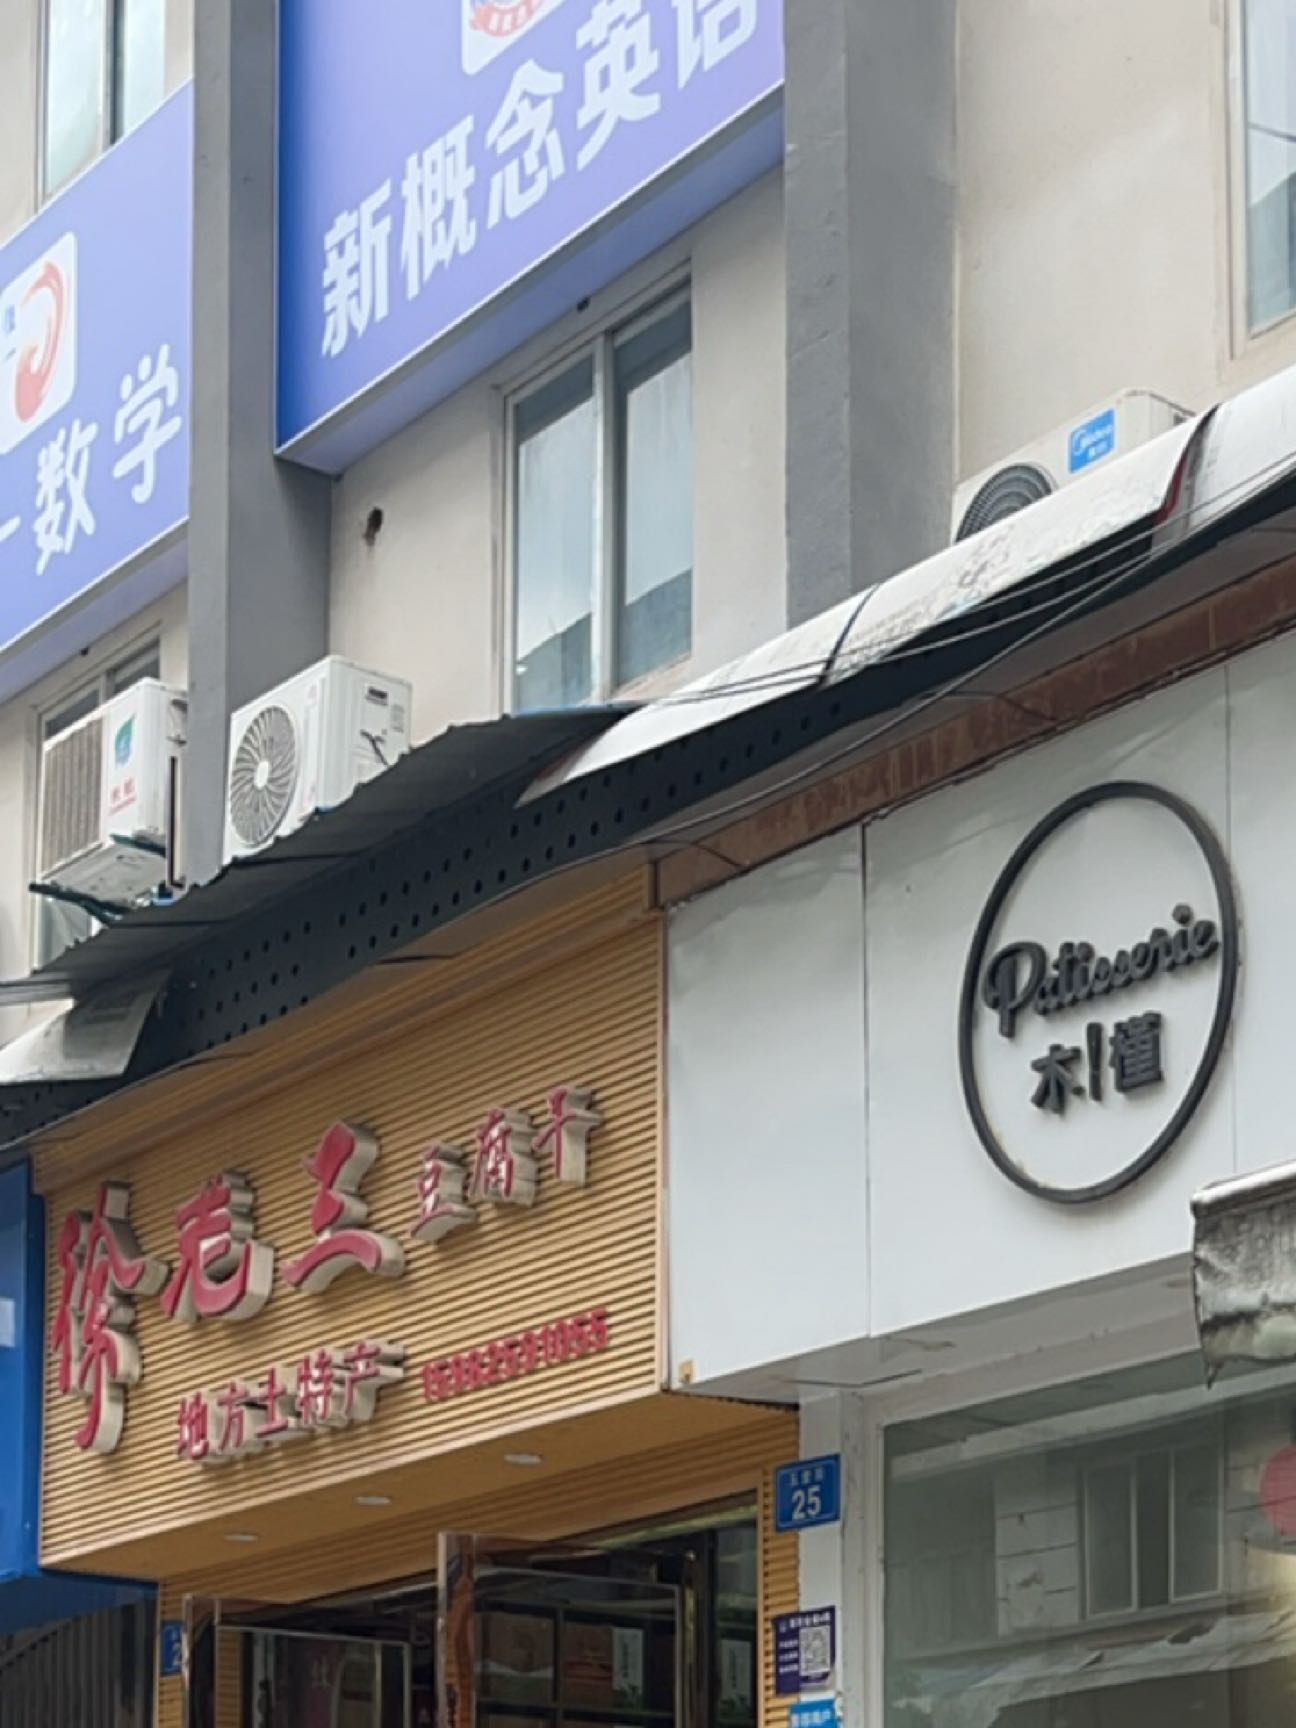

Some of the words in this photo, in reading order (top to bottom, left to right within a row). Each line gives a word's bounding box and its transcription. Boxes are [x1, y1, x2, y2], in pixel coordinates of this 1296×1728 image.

[321, 0, 758, 358] 新概念英语
[982, 903, 1219, 1038] Patisserie
[178, 1340, 405, 1464] 地方土特产
[791, 1485, 822, 1521] 25
